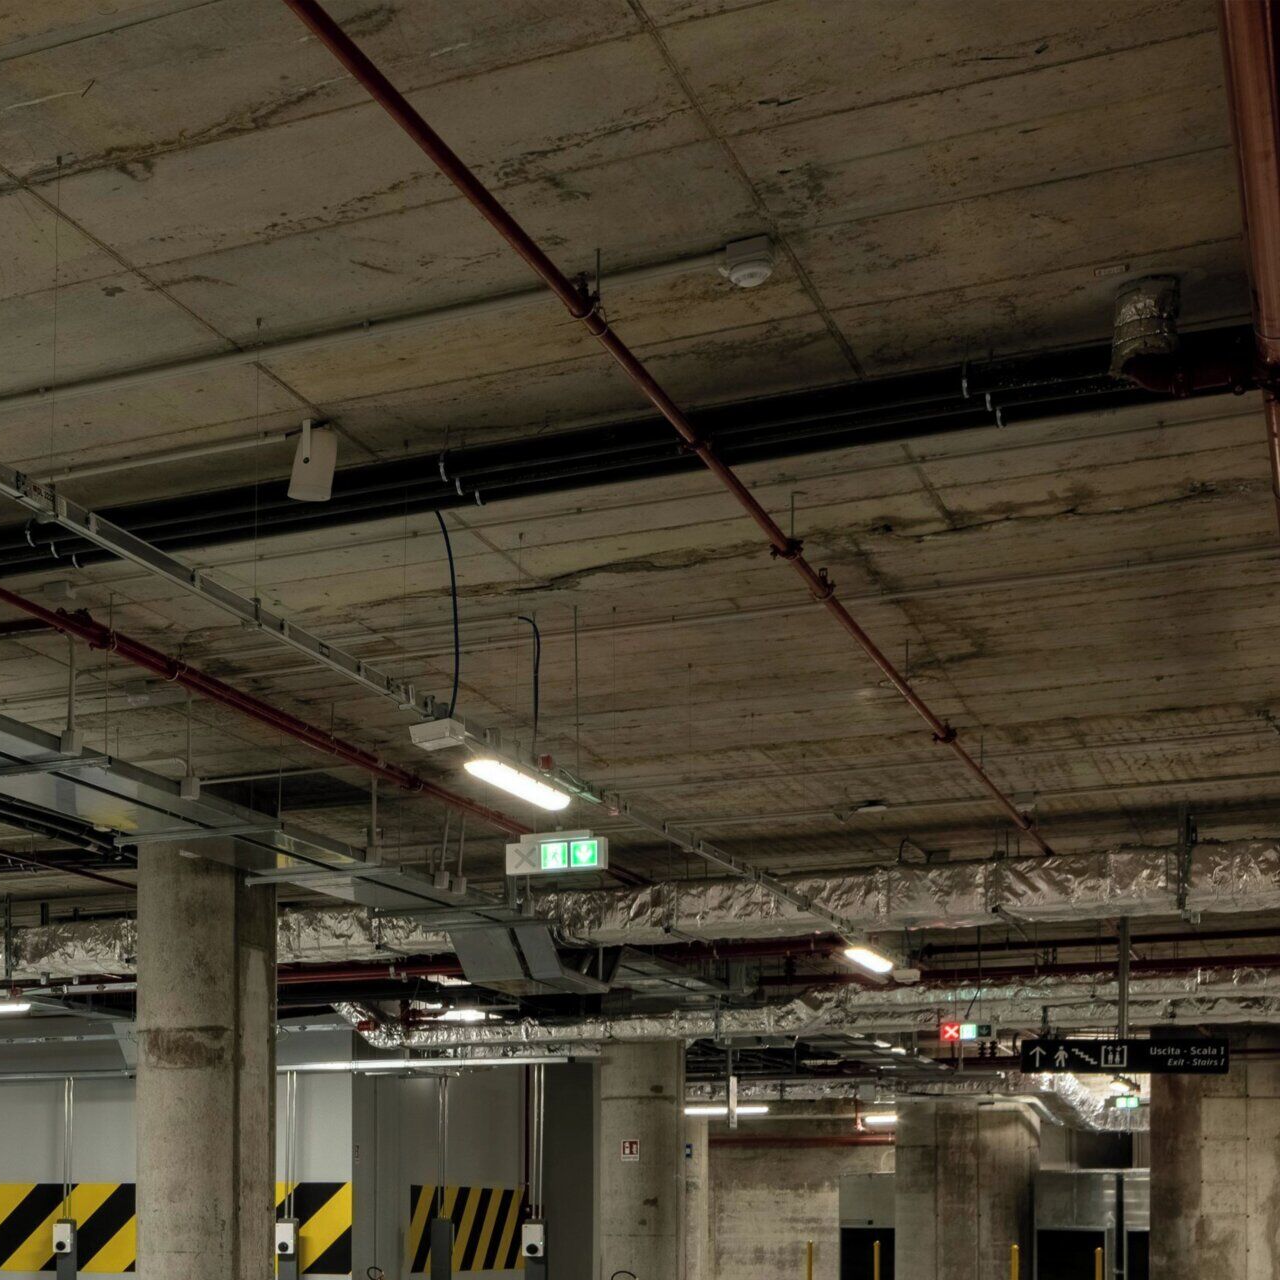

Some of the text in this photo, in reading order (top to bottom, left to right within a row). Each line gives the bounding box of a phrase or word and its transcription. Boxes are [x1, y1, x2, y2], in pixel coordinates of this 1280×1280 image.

[1149, 1046, 1180, 1055] Uscita
[1190, 1046, 1217, 1055] Scala
[1167, 1058, 1185, 1066] Exit
[1192, 1058, 1218, 1066] Stairs
